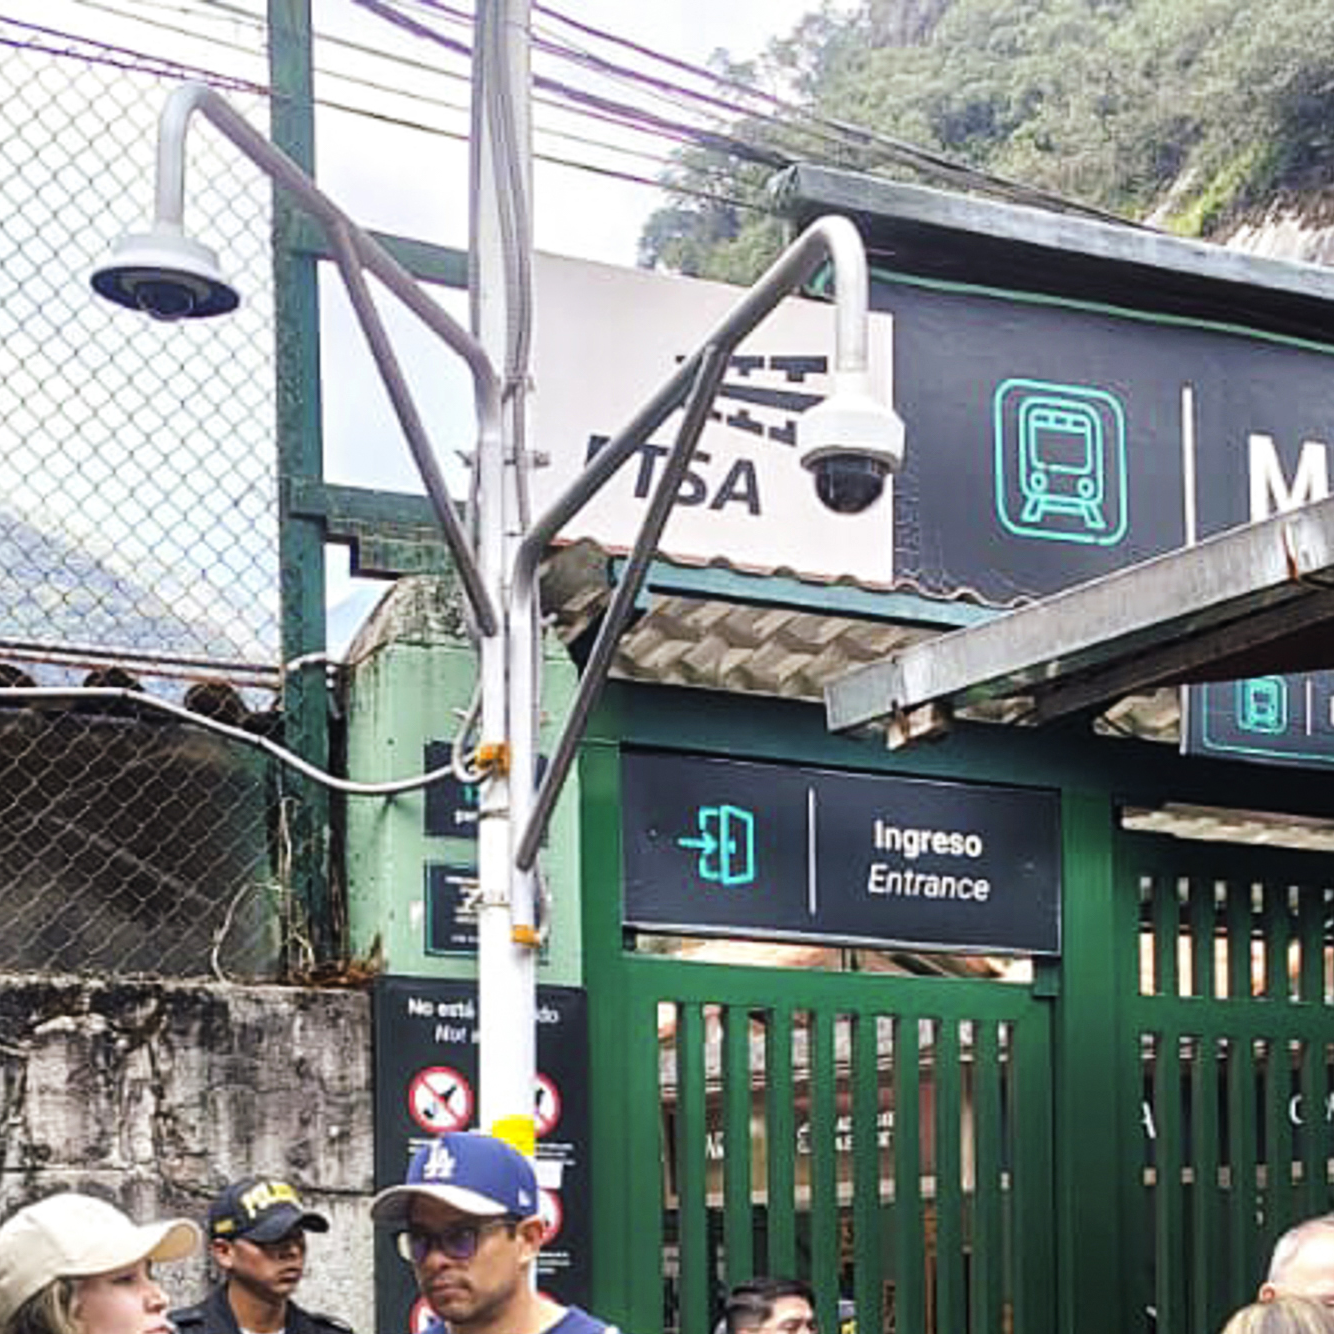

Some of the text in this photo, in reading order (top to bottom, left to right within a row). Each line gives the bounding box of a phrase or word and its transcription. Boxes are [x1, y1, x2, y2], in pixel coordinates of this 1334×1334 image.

[874, 819, 983, 858] Ingreso
[868, 863, 991, 901] Entrance
[408, 997, 434, 1016] No
